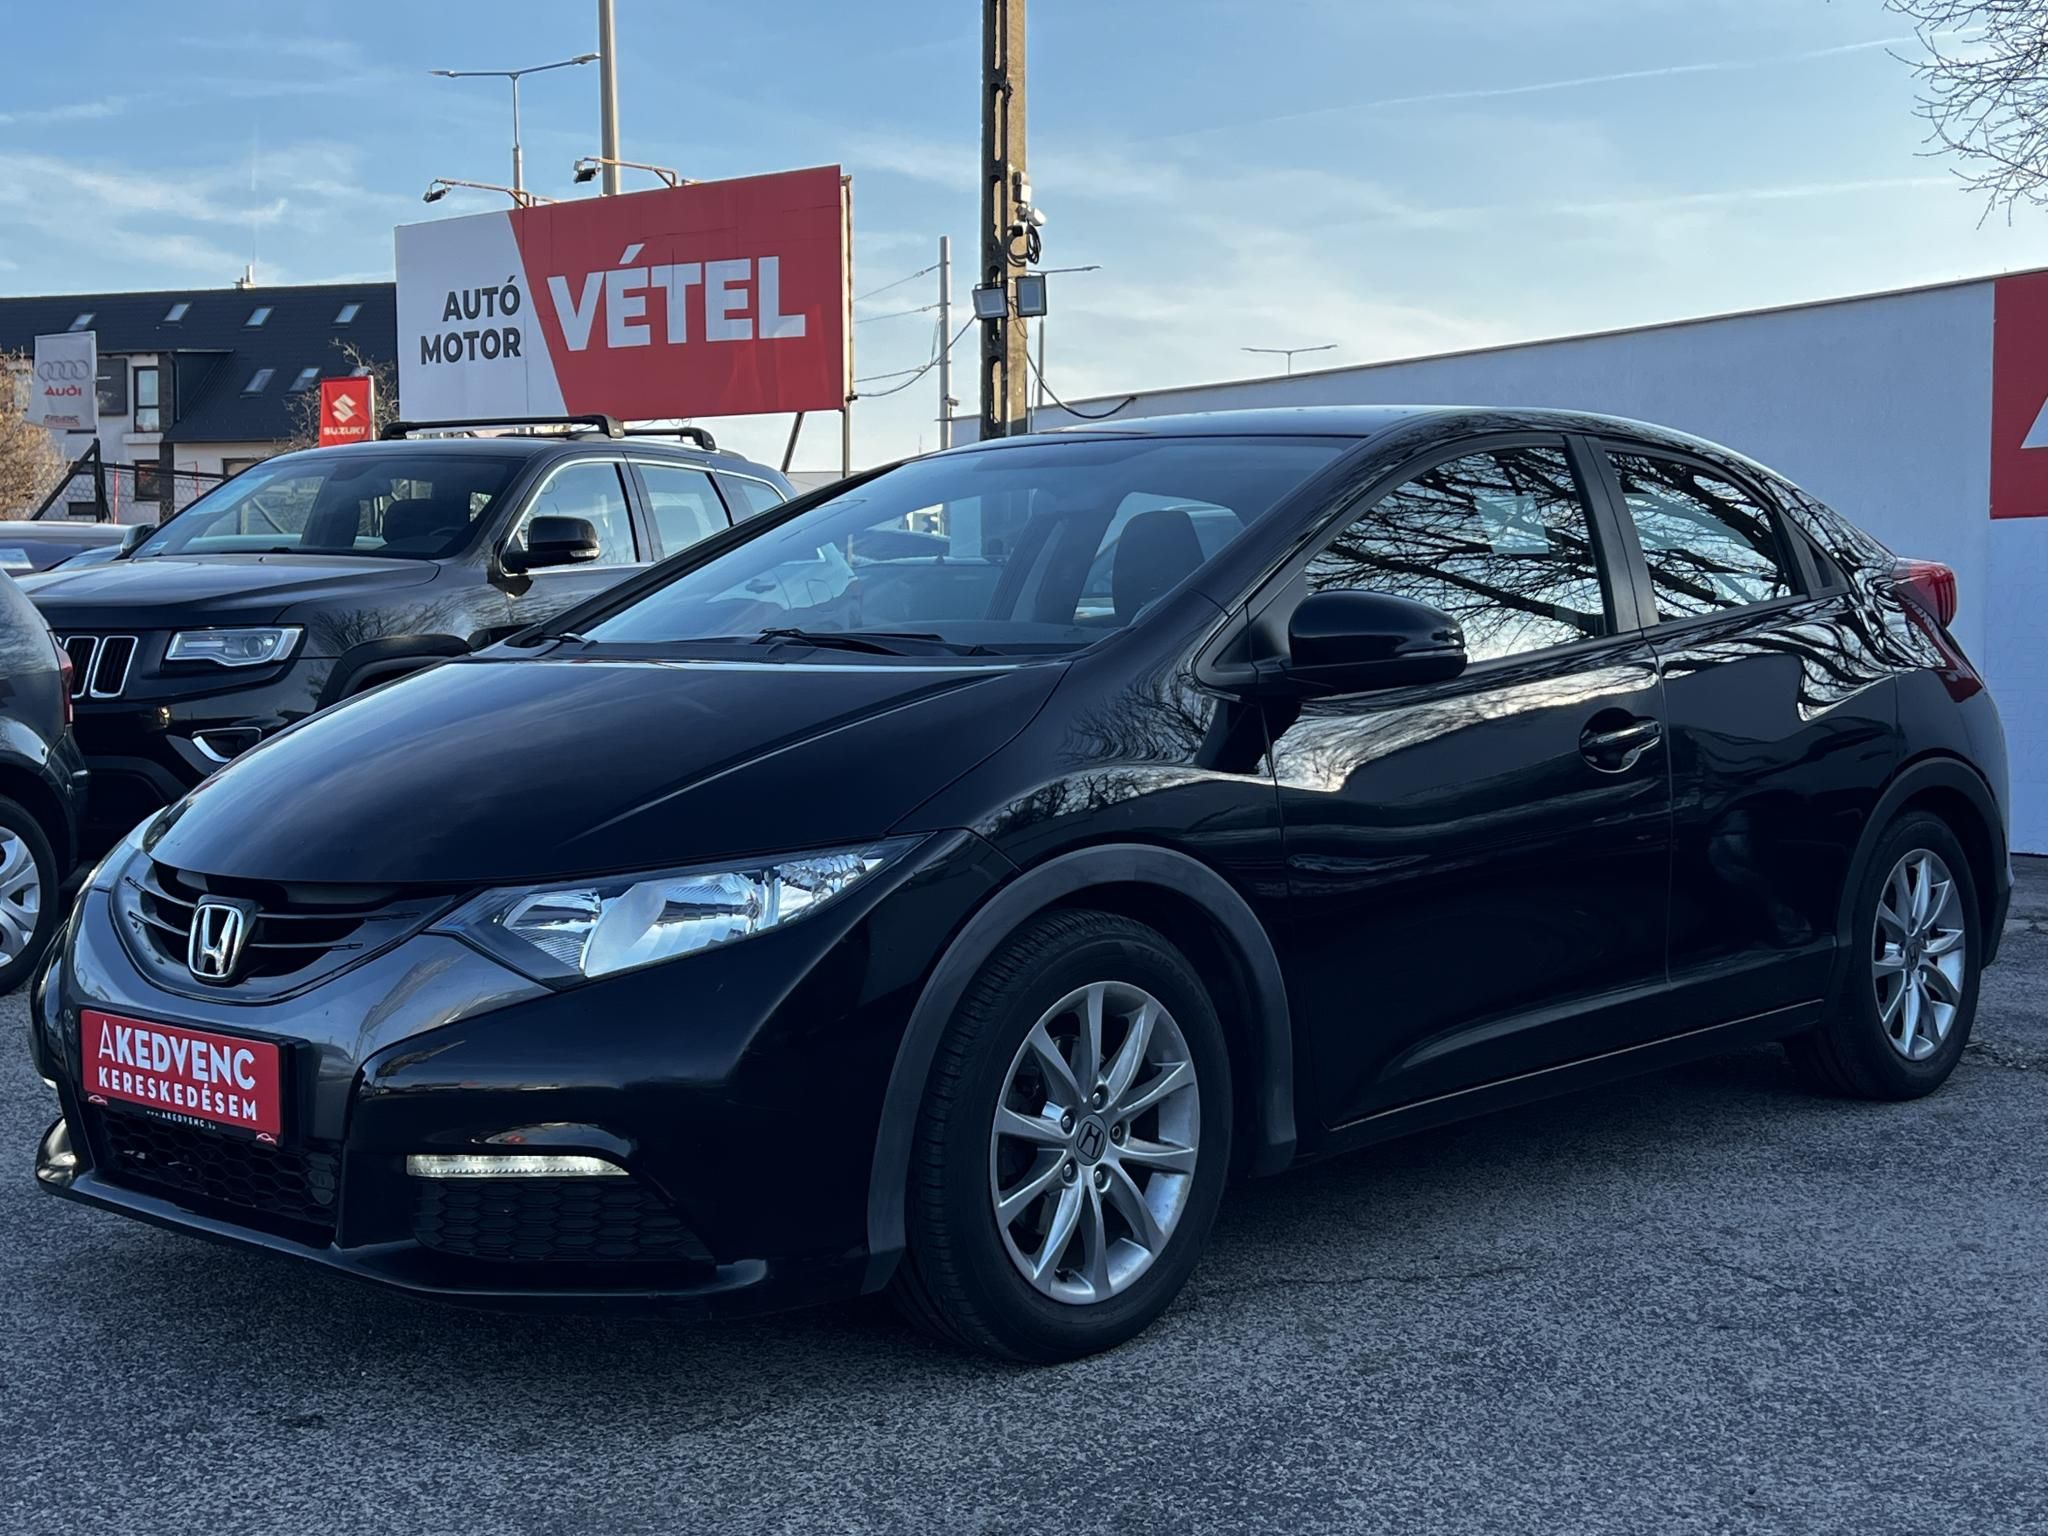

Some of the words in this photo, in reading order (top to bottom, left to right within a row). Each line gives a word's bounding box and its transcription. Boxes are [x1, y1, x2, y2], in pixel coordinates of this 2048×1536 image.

[442, 275, 520, 322] AUTÓ
[547, 243, 806, 352] VÉTEL
[420, 327, 521, 365] MOTOR
[323, 426, 365, 436] SUZUKI
[98, 1019, 256, 1090] AKEDVENC
[98, 1066, 257, 1121] KERESKEDÉSEM
